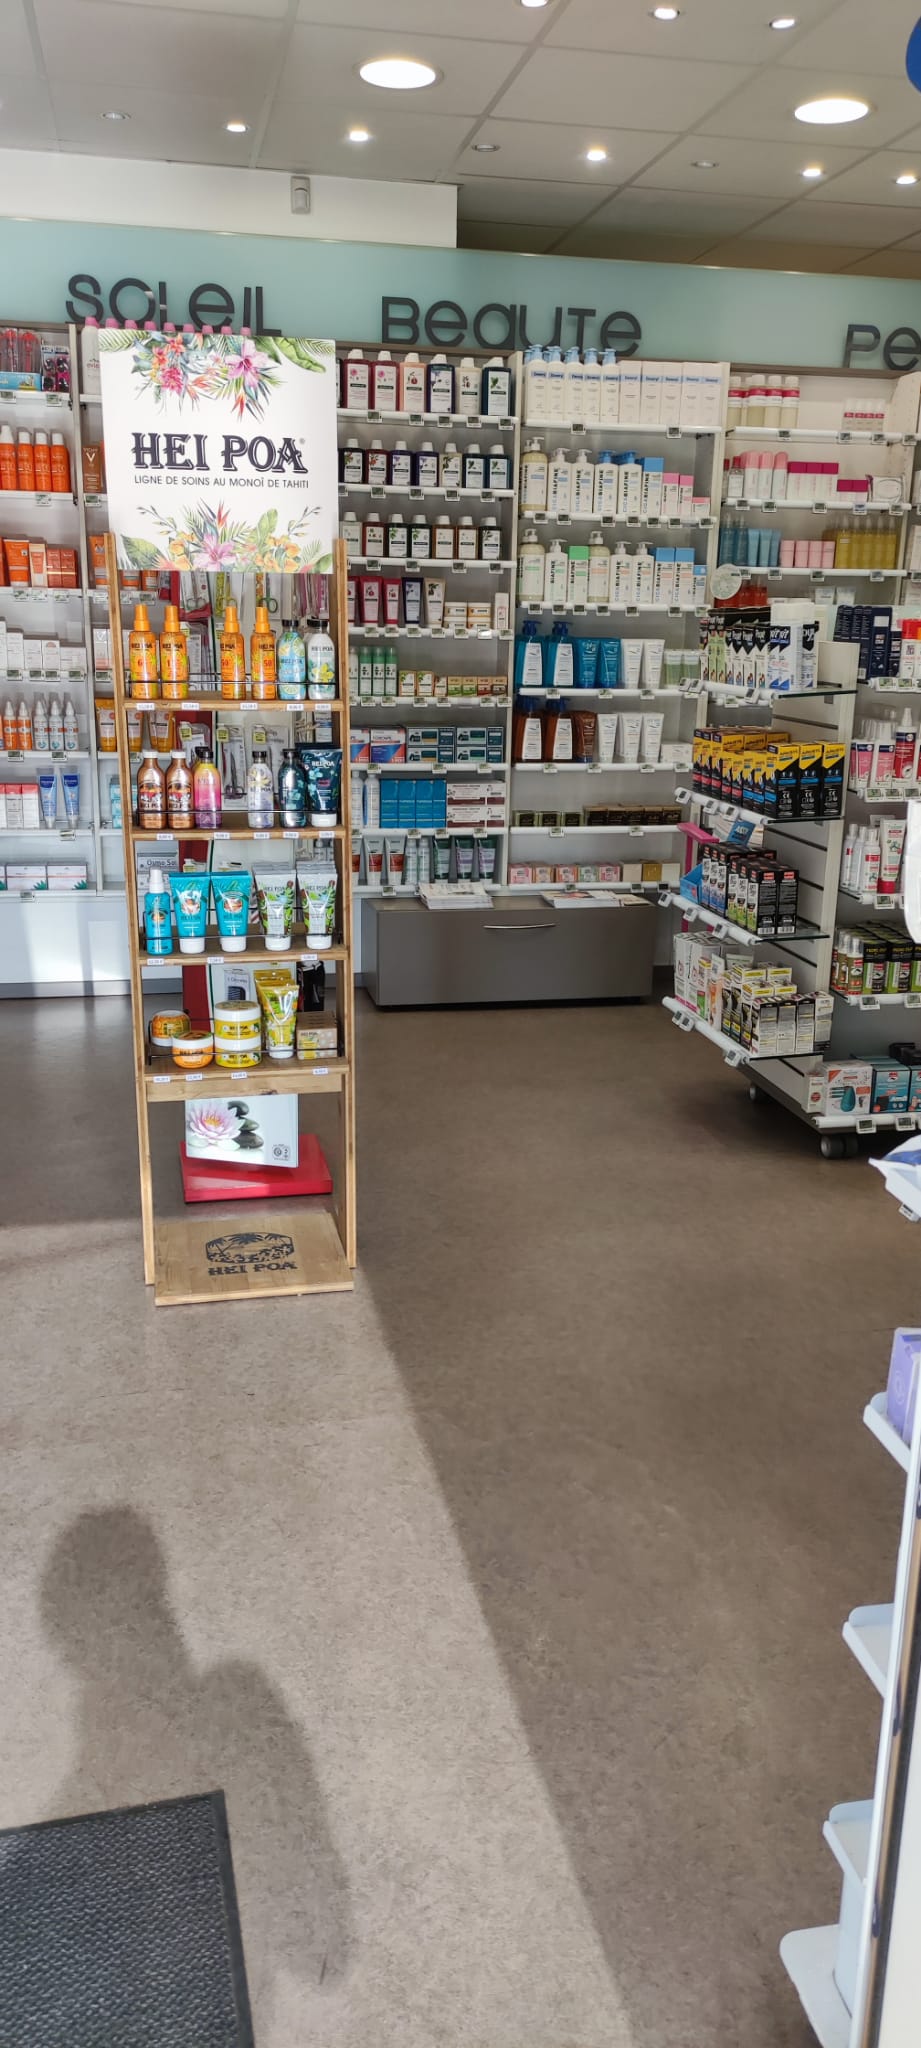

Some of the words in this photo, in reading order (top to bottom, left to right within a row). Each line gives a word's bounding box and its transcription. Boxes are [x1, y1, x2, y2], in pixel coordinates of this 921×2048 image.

[131, 432, 210, 471] HEI
[221, 435, 309, 474] POA
[134, 475, 163, 485] LIGNE
[165, 476, 178, 485] DE
[181, 476, 210, 486] SOINS
[213, 477, 226, 487] AU
[229, 477, 264, 488] MONOÏ
[267, 479, 280, 488] DE
[282, 479, 309, 489] TAHITI
[208, 1264, 248, 1276] HEI
[253, 1262, 299, 1272] POA
